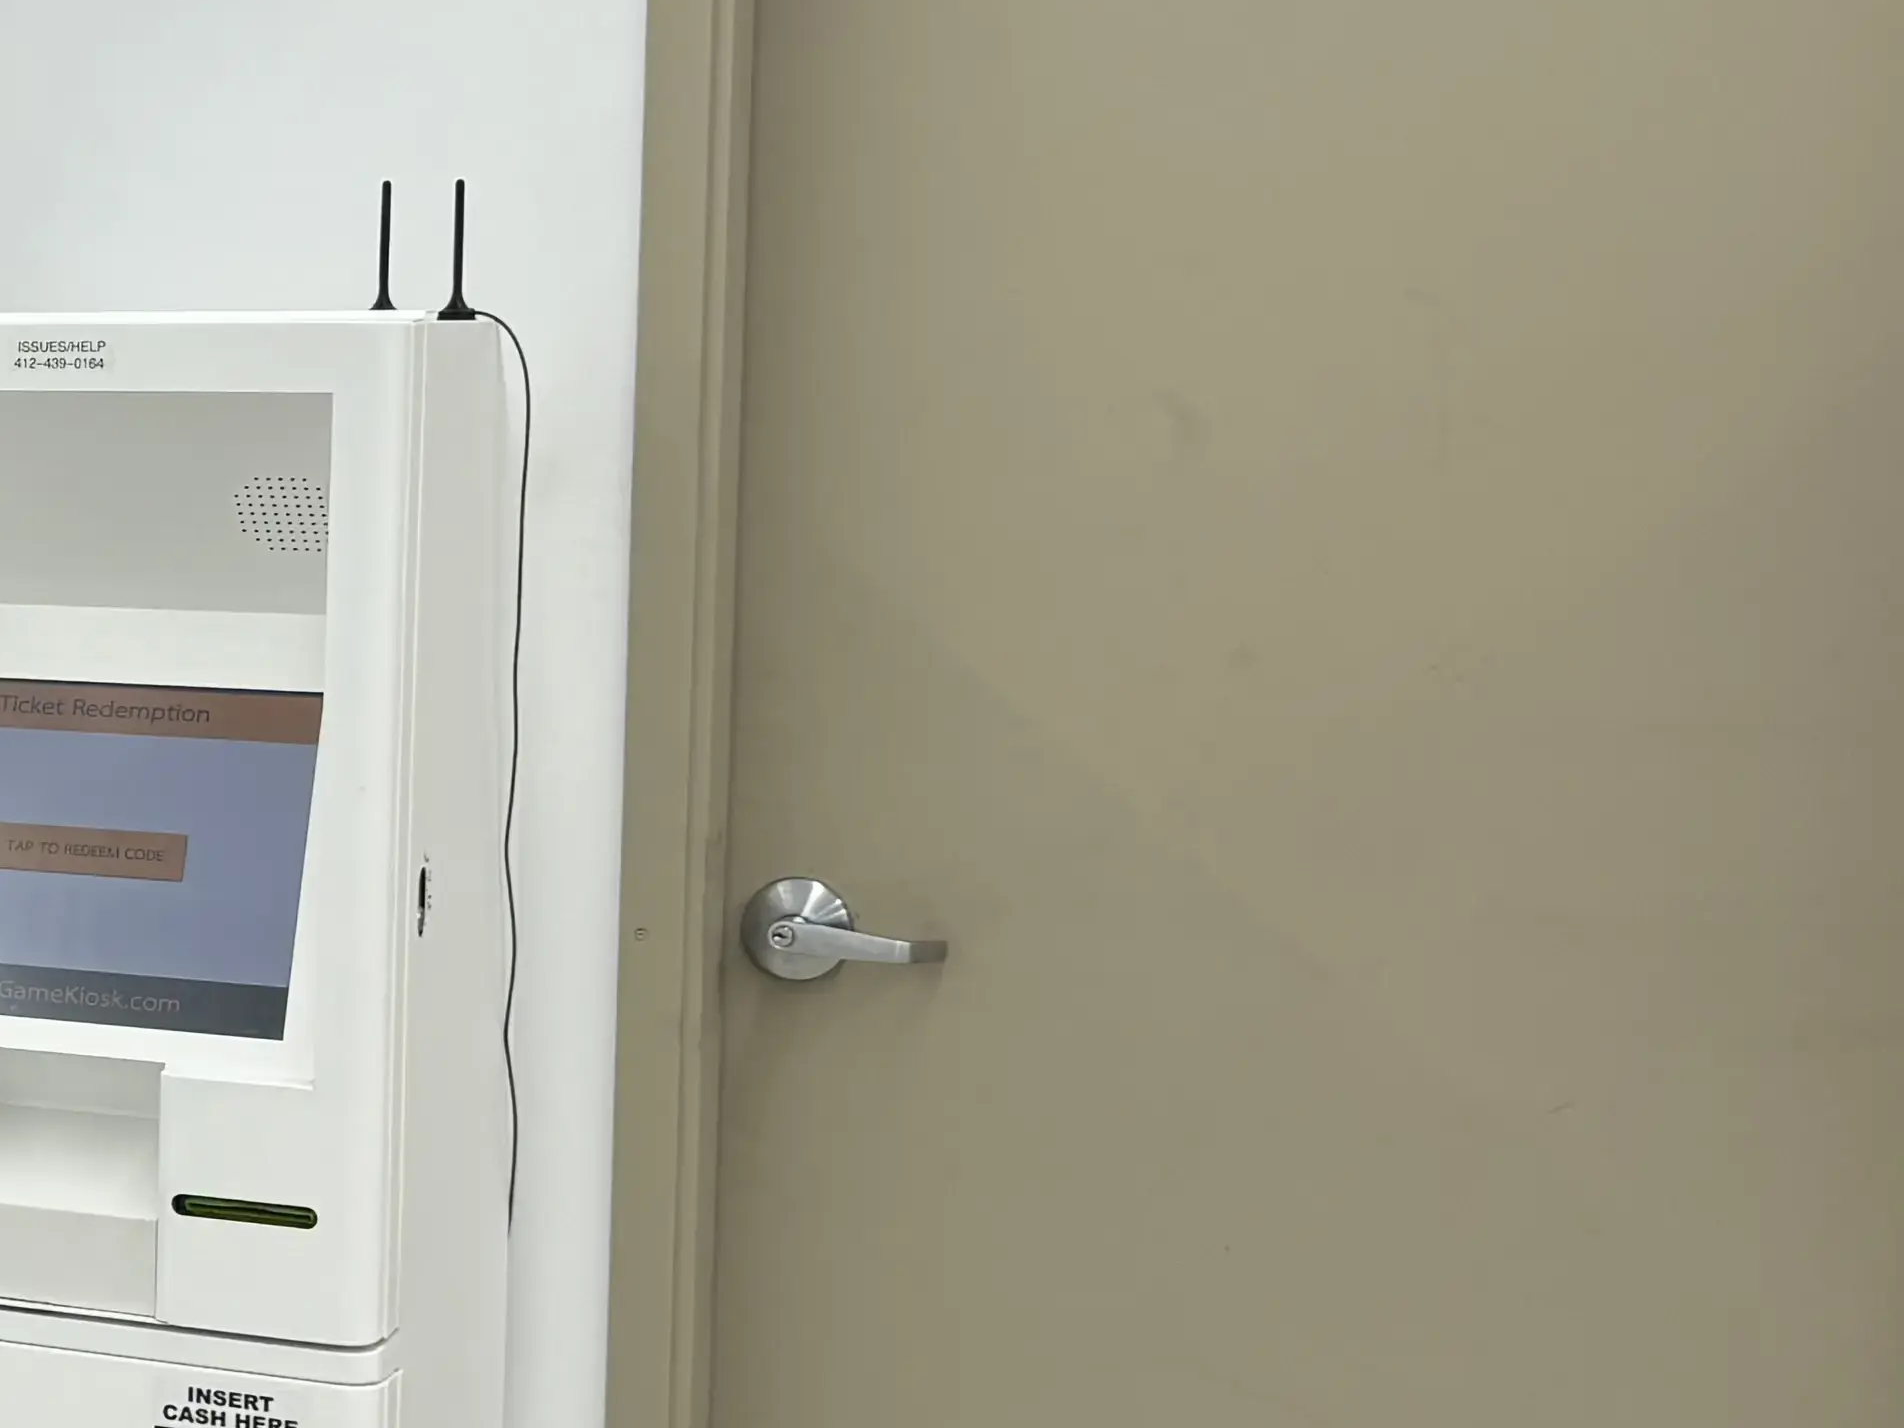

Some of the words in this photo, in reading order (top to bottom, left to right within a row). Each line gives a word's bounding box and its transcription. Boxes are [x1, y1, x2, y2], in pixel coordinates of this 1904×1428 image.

[17, 340, 106, 354] ISSUES/HELP
[13, 357, 105, 371] 412-439-0164
[72, 698, 210, 726] Redemption
[7, 839, 34, 853] TAP
[40, 841, 60, 855] TO
[64, 843, 120, 859] REDEEM
[124, 846, 165, 862] CODE
[187, 1386, 274, 1413] INSERT
[162, 1403, 227, 1428] CASH
